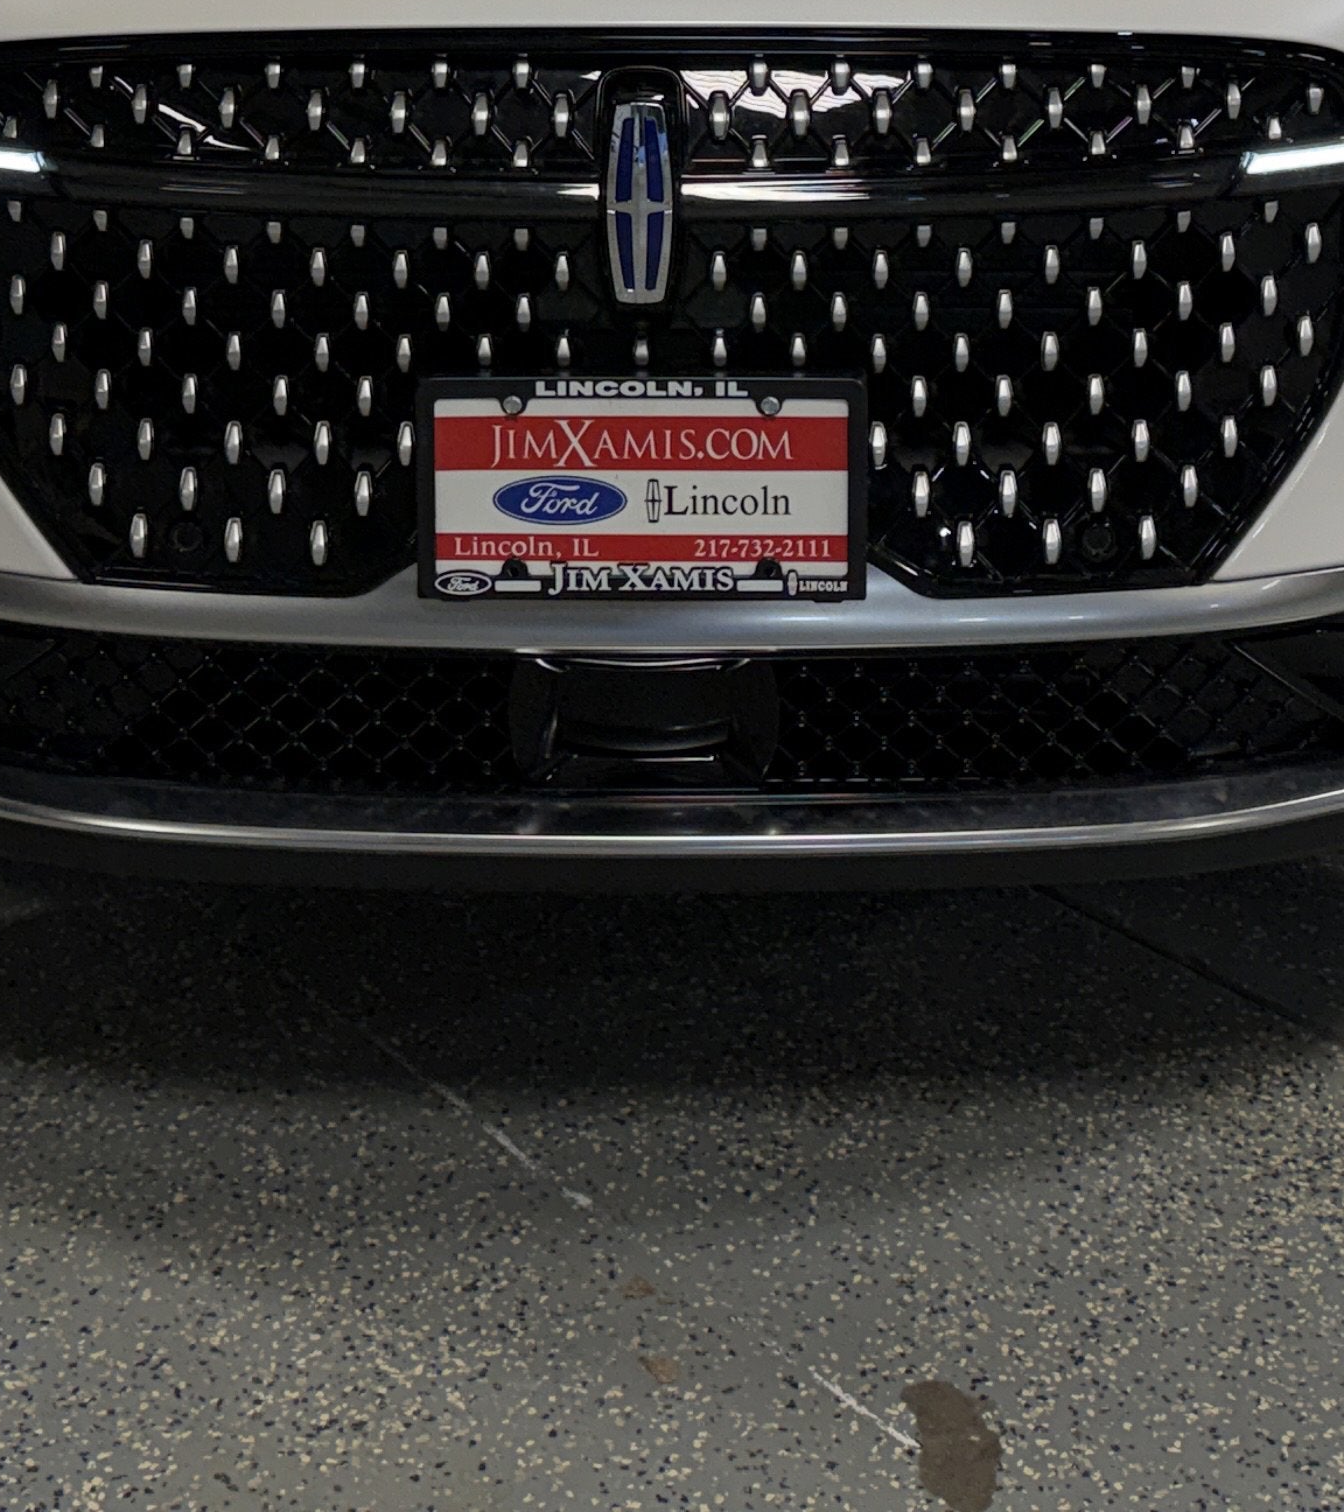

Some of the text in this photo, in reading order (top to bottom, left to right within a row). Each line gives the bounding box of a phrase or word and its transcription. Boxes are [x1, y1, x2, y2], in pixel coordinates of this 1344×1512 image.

[535, 380, 749, 398] LINCOLN, IL
[519, 481, 599, 517] Ford
[663, 485, 792, 517] Lincoln
[453, 537, 600, 559] Lincoln, IL
[693, 539, 831, 558] 217-732-2111
[446, 576, 482, 592] Ford
[548, 562, 735, 596] JIM XAMIS
[798, 580, 849, 593] LINCOLN
